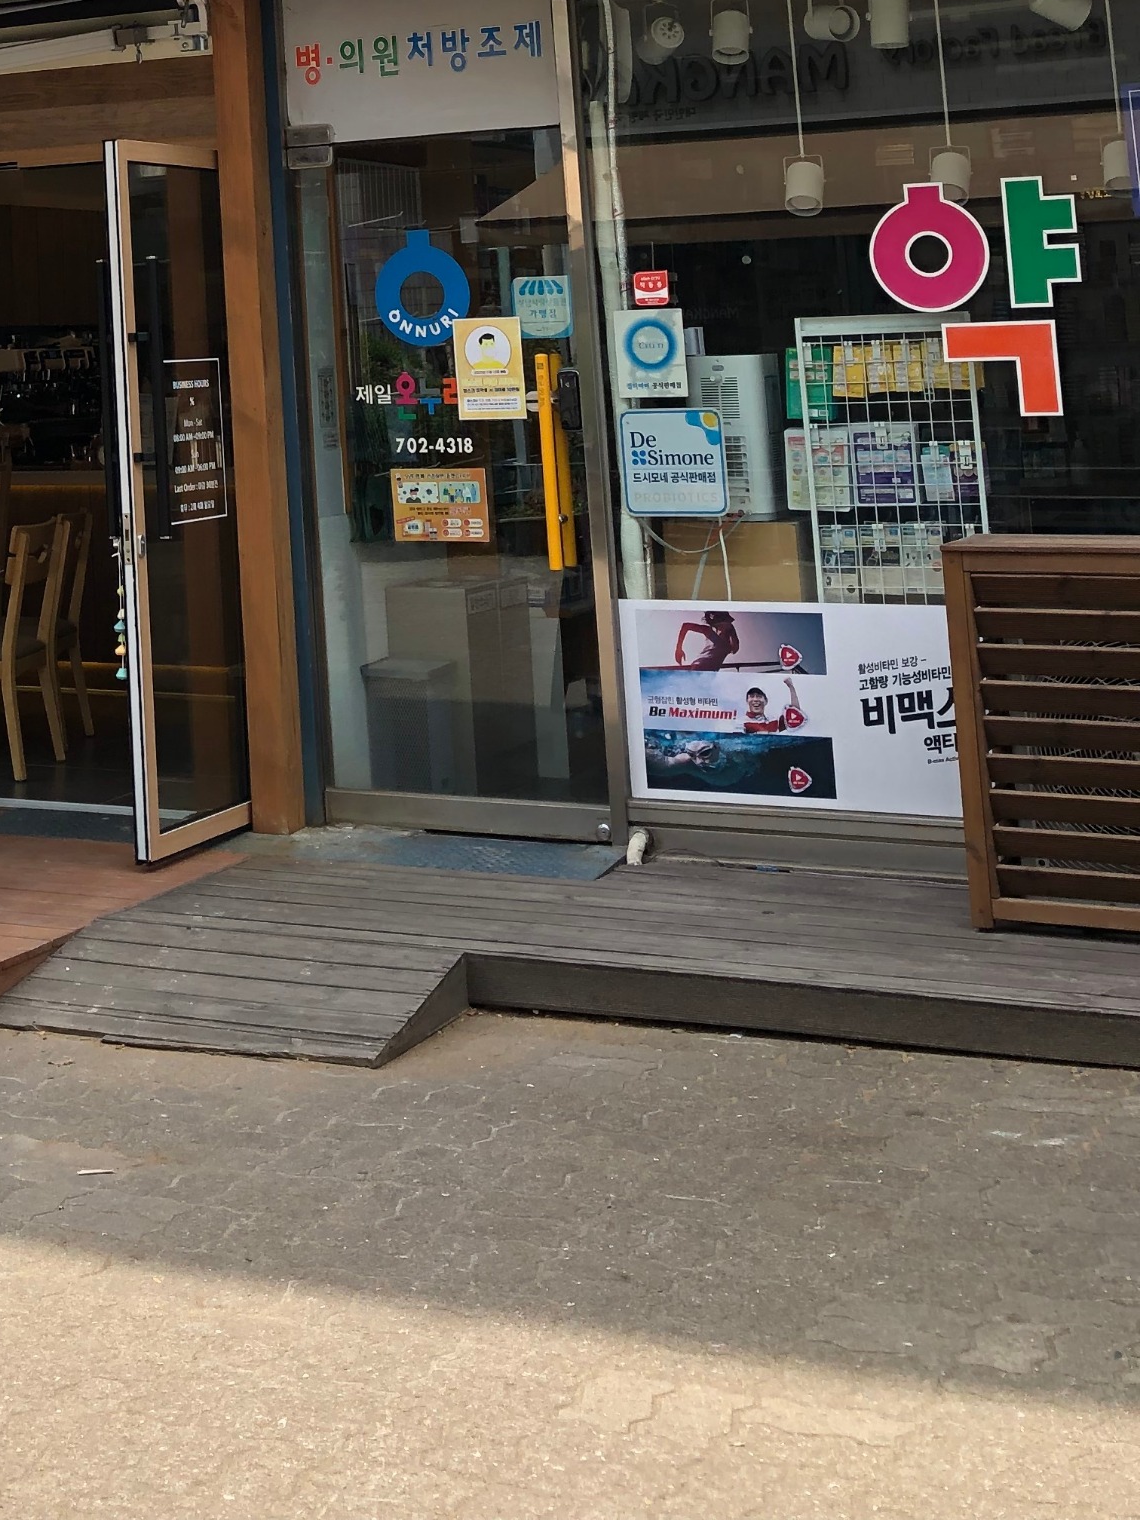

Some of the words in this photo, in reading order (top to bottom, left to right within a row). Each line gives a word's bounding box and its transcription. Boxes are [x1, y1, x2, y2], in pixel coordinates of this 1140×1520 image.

[869, 175, 1082, 418] 약
[388, 308, 459, 338] ONNURI
[355, 384, 391, 405] 제일
[396, 437, 474, 454] 702-4318
[630, 432, 657, 448] De
[648, 450, 714, 466] Simone
[633, 472, 668, 483] 드시모네
[671, 472, 716, 483] 공식판매점
[858, 658, 899, 675] 활성비타민
[901, 655, 918, 668] 보강
[859, 675, 888, 690] 고함량
[892, 666, 951, 686] 기능성비타민
[697, 697, 718, 707] 비타민
[649, 706, 666, 717] Be
[668, 707, 737, 720] Maximum!
